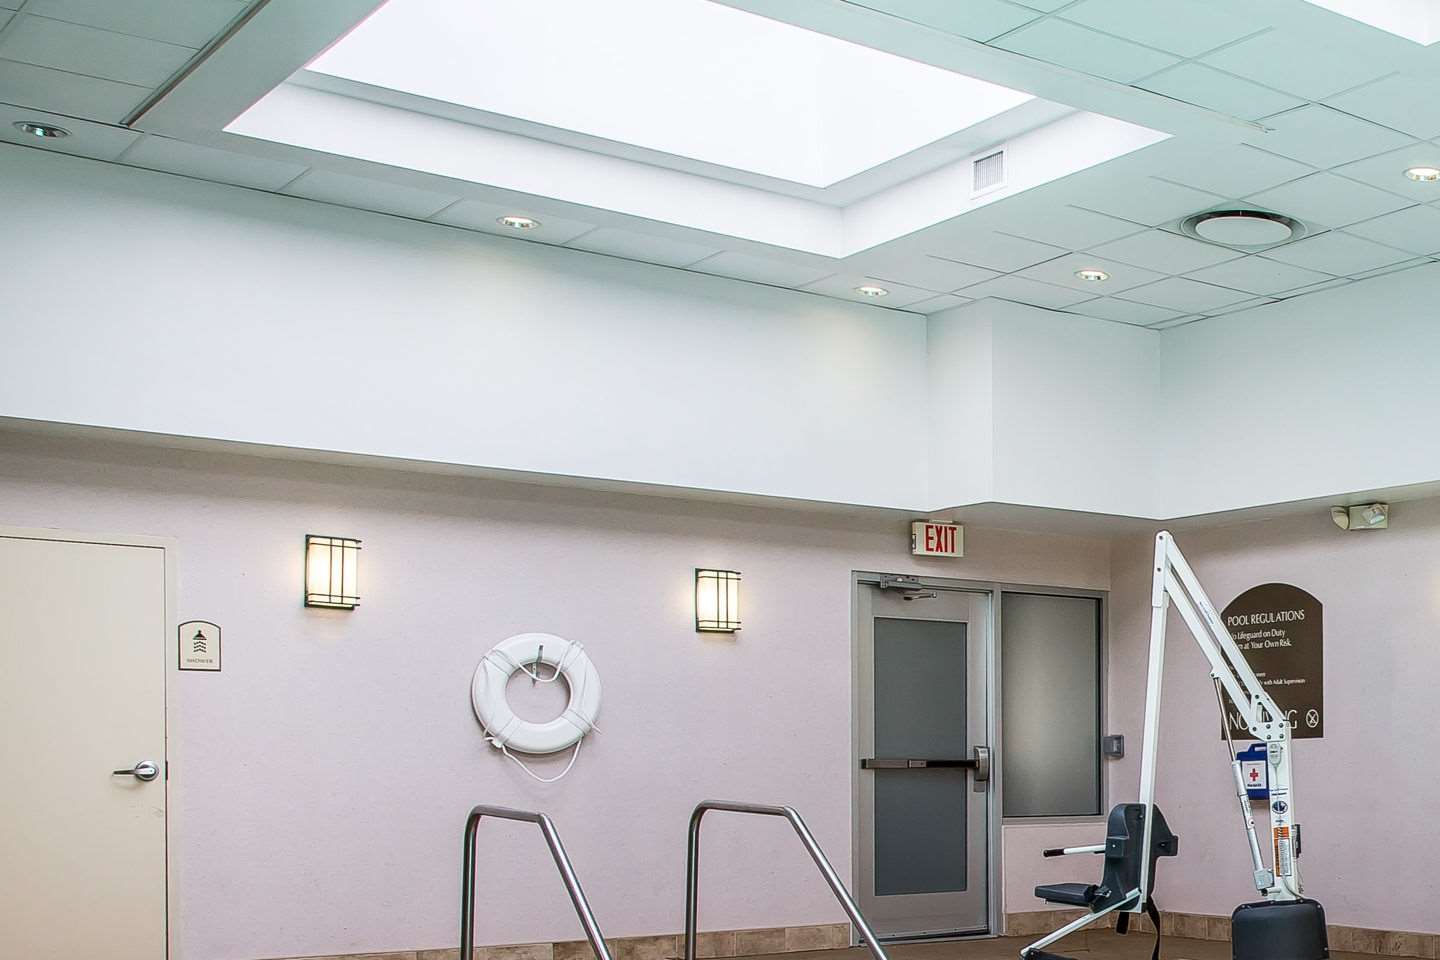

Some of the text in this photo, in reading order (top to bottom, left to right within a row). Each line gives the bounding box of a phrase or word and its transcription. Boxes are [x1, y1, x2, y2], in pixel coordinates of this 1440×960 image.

[925, 525, 957, 553] EXIT
[1227, 609, 1305, 627] POOL REGULATIONS
[1237, 630, 1262, 641] Lifeguard
[1271, 628, 1285, 638] Duty
[1251, 641, 1263, 649] Your
[1264, 640, 1279, 648] Own
